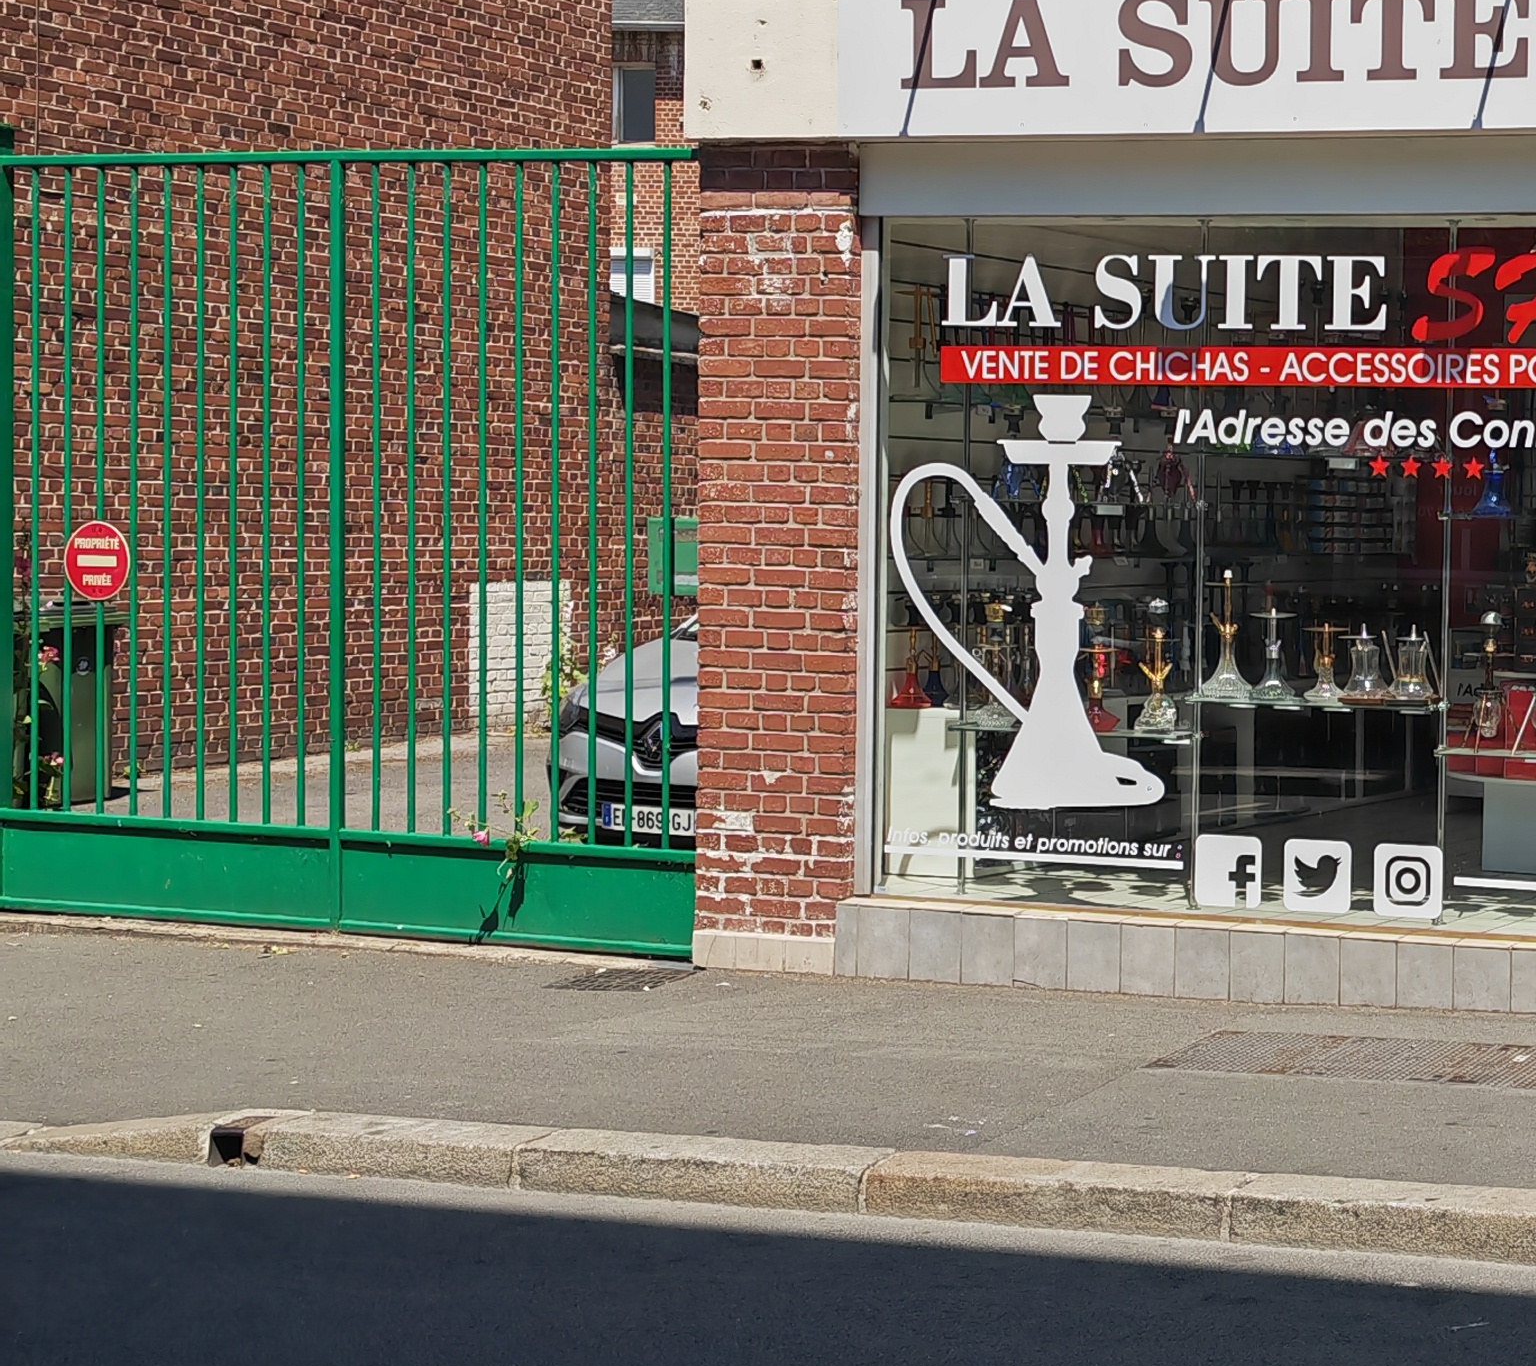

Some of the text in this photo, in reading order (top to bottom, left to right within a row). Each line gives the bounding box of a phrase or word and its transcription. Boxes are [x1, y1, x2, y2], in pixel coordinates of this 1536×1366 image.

[941, 253, 1062, 328] LA
[1094, 253, 1388, 331] SUITE
[961, 349, 1049, 380] VENTE
[1060, 350, 1099, 381] DE
[1108, 350, 1250, 382] CHICHAS
[1279, 351, 1500, 385] ACCESSOIRES
[1173, 408, 1349, 447] l'Adresse
[1363, 410, 1437, 449] des
[74, 536, 120, 550] PROPRIÉTÉ
[82, 573, 113, 586] PRIVÉE
[938, 830, 1010, 850] produits
[1014, 833, 1034, 850] et
[1036, 836, 1139, 855] promotions
[1143, 842, 1172, 858] sur
